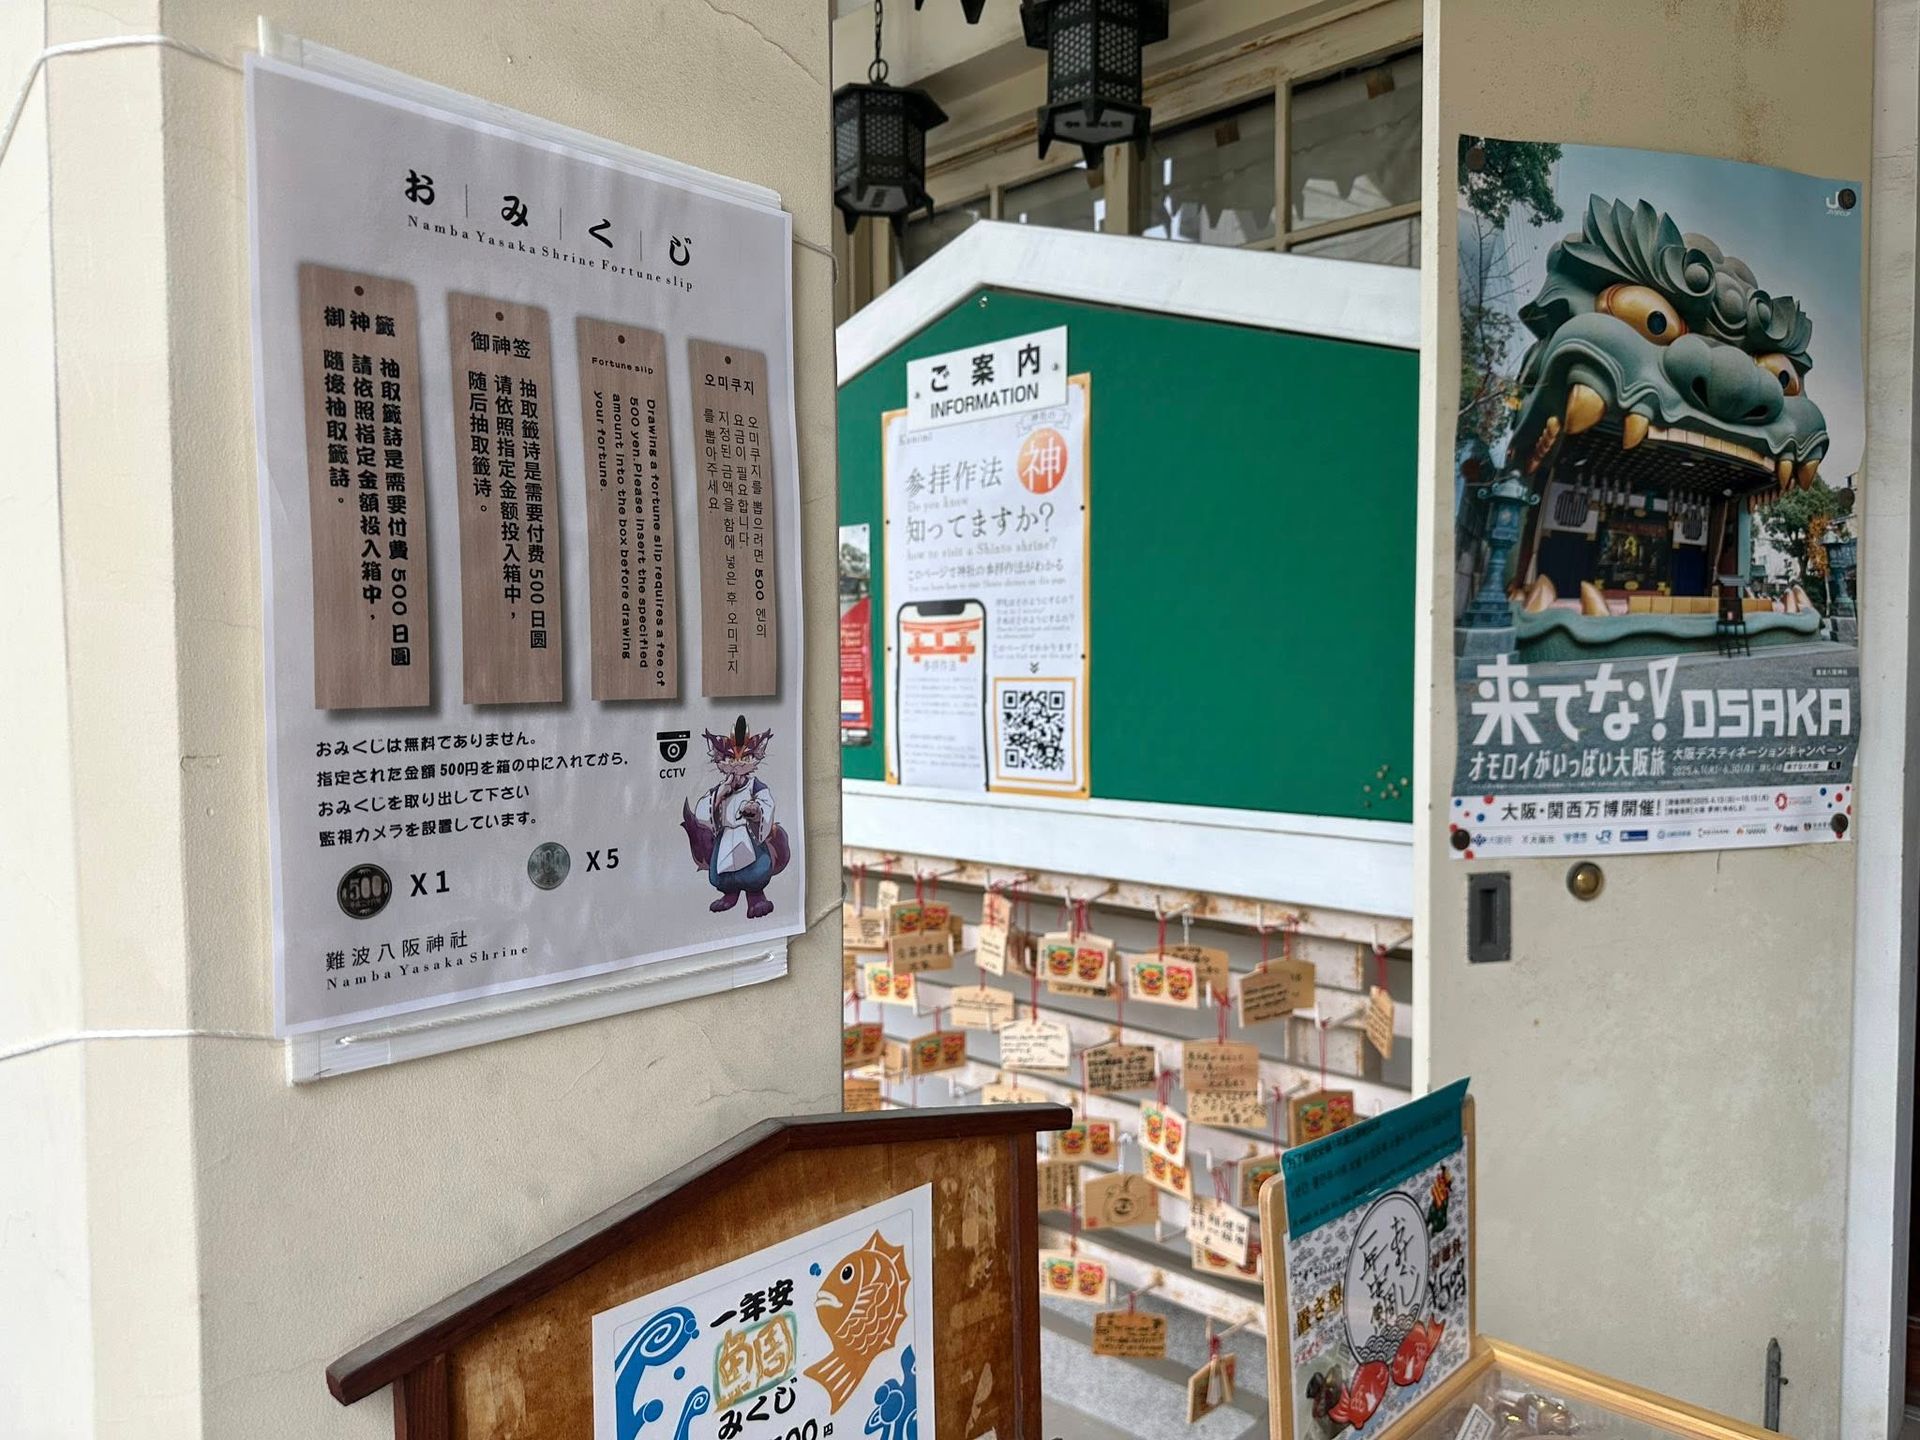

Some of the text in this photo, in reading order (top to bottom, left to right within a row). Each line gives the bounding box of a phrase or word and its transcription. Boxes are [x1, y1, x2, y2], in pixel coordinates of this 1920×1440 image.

[407, 214, 694, 292] Namba Yasaka Shrine Fortune slip
[323, 305, 396, 338] 御神籤
[470, 331, 532, 359] 御神签
[591, 356, 654, 375] Fortune slip
[704, 373, 755, 396] 오미쿠지
[931, 343, 1041, 393] ご案内
[629, 396, 641, 427] 500
[703, 408, 715, 424] 를
[930, 382, 1039, 419] INFORMATION
[594, 390, 608, 492] your fortune.
[718, 411, 731, 459] 지정된
[733, 414, 747, 461] 요금이
[748, 416, 763, 496] 오미쿠지를
[905, 456, 1003, 499] 参拝作法
[1023, 436, 1061, 492] 神
[721, 464, 735, 513] 금액을
[612, 394, 632, 660] amount into the box before drawing
[635, 519, 647, 564] insert
[647, 399, 666, 687] Drawing a fortune slip requires a fee of
[724, 518, 736, 549] 함에
[752, 499, 765, 563] 뽑으려면
[906, 502, 1055, 545] 知ってますか?
[637, 567, 647, 594] the
[726, 591, 738, 606] 후
[754, 568, 765, 601] 500
[637, 597, 648, 668] specified
[727, 612, 738, 674] 오미쿠지
[1681, 688, 1851, 739] OSAKA
[315, 731, 537, 758] おみくじは無料でありません。
[1468, 746, 1666, 783] オモロイがいっぱい大阪旅
[1672, 745, 1848, 761] 大阪デスティネーションキャンペーン
[659, 767, 686, 779] CCTV
[318, 784, 530, 818] おみくじを取り出して下さい
[1501, 799, 1661, 821] 大阪・関西万博開催!
[319, 810, 538, 848] 監視カメラを設置しています。
[586, 848, 620, 873] X 5
[410, 870, 450, 897] X 1
[325, 929, 469, 972] 難波八阪神社
[326, 945, 529, 991] Namba Yasaka Shrine
[709, 1279, 795, 1328] 一年安
[717, 1377, 798, 1440] みくじ
